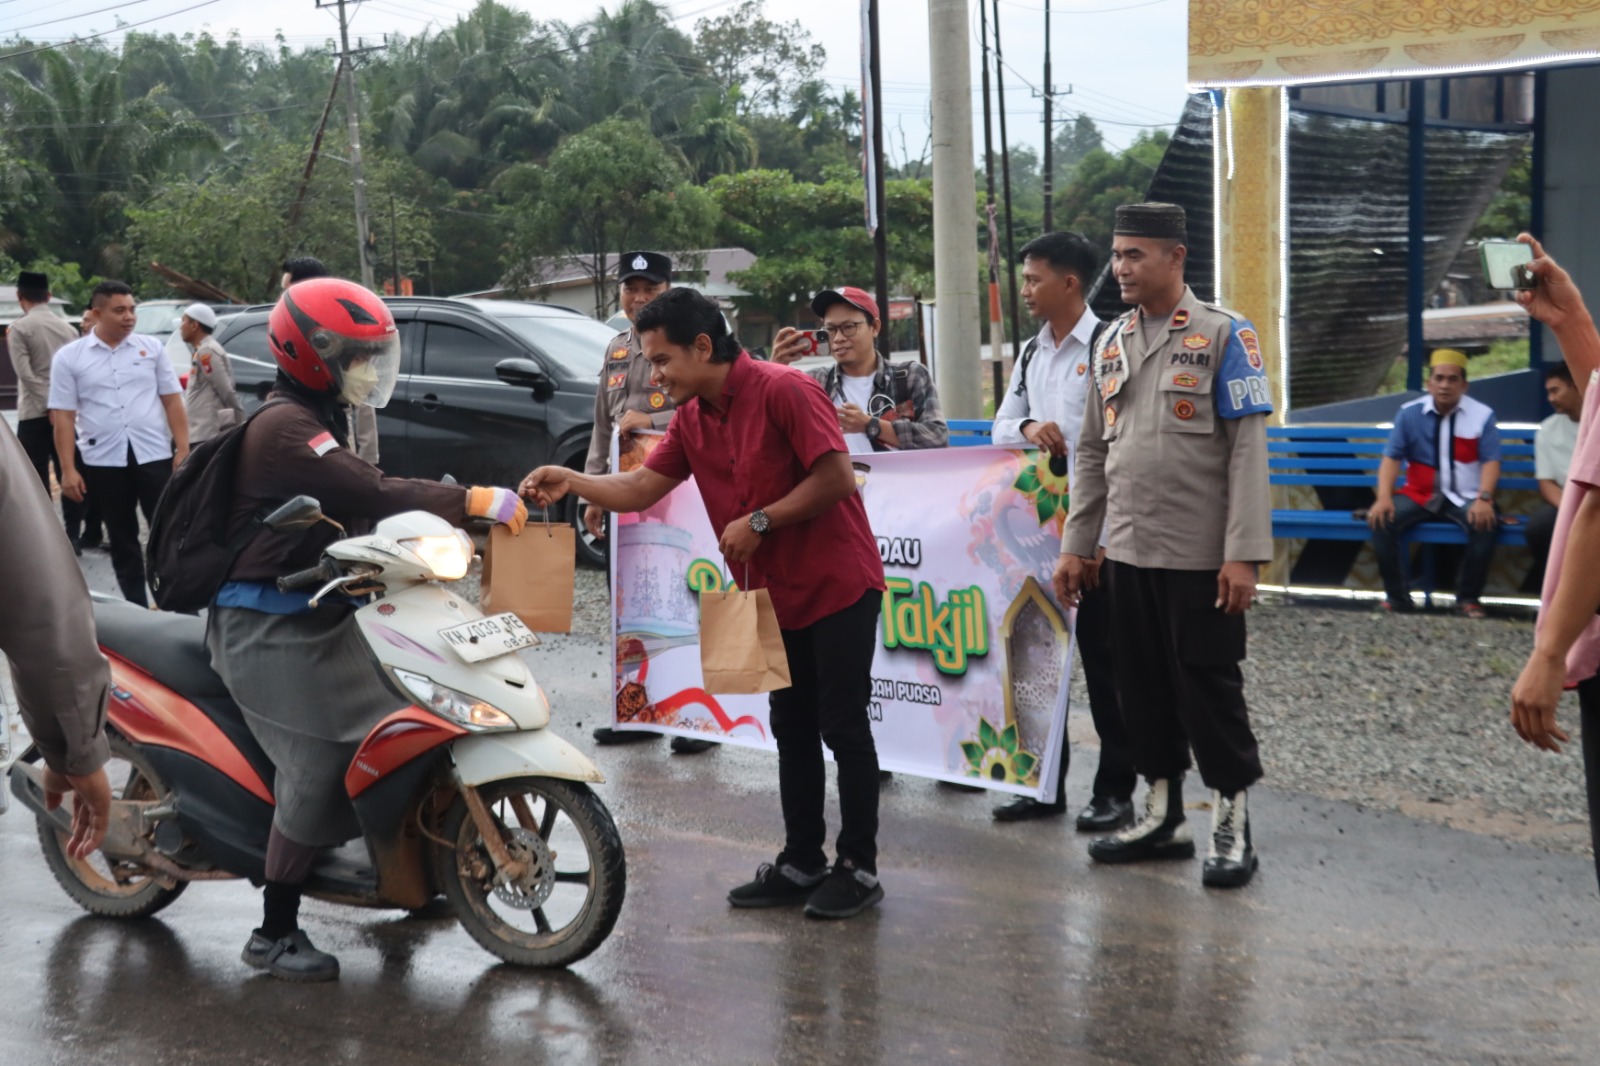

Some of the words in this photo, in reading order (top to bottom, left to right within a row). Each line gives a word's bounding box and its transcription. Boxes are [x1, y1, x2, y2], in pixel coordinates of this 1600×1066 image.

[1171, 352, 1211, 367] POLRI
[875, 536, 922, 566] DAU
[882, 576, 989, 674] Takjil
[444, 631, 468, 645] KH
[896, 681, 942, 705] PUASA
